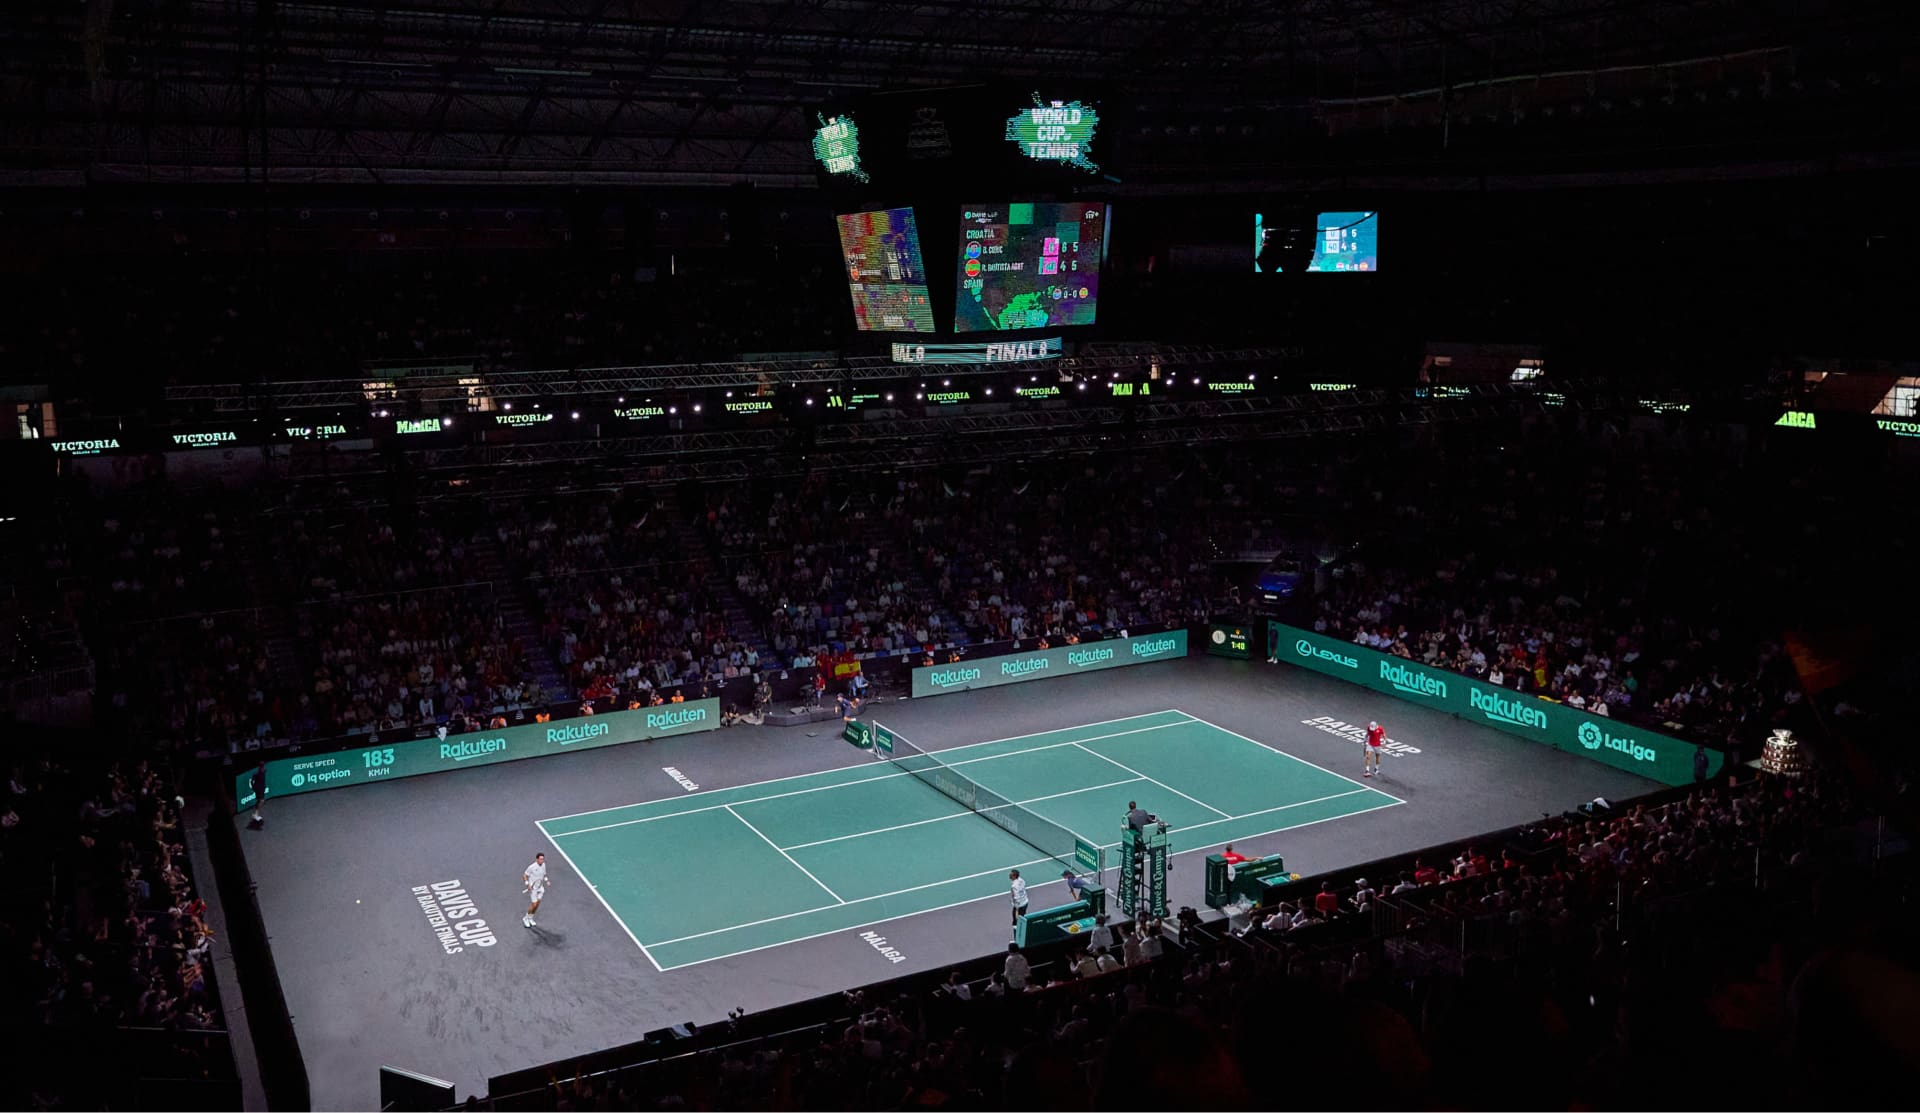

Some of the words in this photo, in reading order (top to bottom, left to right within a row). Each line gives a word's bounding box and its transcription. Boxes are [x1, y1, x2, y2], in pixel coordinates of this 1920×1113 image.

[1031, 108, 1081, 125] WORLD
[821, 123, 848, 141] WORLD
[1037, 126, 1066, 141] CUP
[1029, 143, 1078, 158] TENNIS
[828, 155, 855, 173] TENNIS
[966, 228, 995, 239] CROATIA
[1351, 228, 1357, 238] 5
[1072, 241, 1079, 252] 5
[1341, 242, 1347, 251] 4
[1351, 242, 1357, 251] 5
[1059, 260, 1067, 272] 4
[1071, 260, 1079, 271] 5
[963, 278, 984, 289] SPAIN
[986, 343, 1034, 362] FINAL
[1039, 341, 1047, 357] 8
[1208, 383, 1255, 391] VICTORIA
[927, 392, 970, 402] VICTORIA
[725, 402, 773, 412] VICTORIA
[51, 439, 120, 452] VICTORIA
[173, 431, 236, 444] VICTORIA
[1068, 646, 1113, 665] Rakuten
[1132, 638, 1175, 656] Rakuten
[1002, 656, 1048, 675] Rakuten
[1312, 646, 1358, 669] LEXUS
[931, 667, 980, 686] Rakuten
[1380, 660, 1447, 698] Rakuten
[1471, 687, 1547, 729] Rakuten
[647, 708, 706, 728] Rakuten
[547, 721, 609, 743] Rakuten
[440, 737, 506, 760] Rakuten
[1605, 734, 1655, 762] LaLiga
[294, 762, 314, 770] SERVE
[315, 759, 335, 768] SPEED
[362, 748, 394, 768] 183
[320, 768, 351, 782] option
[369, 767, 391, 778] KM/H
[411, 885, 431, 895] BY
[430, 879, 479, 919] DAVIS
[416, 894, 449, 928] RAKUTEN
[434, 926, 464, 954] FINALS
[454, 918, 498, 947] CUP
[859, 930, 907, 964] MÁLAGA
